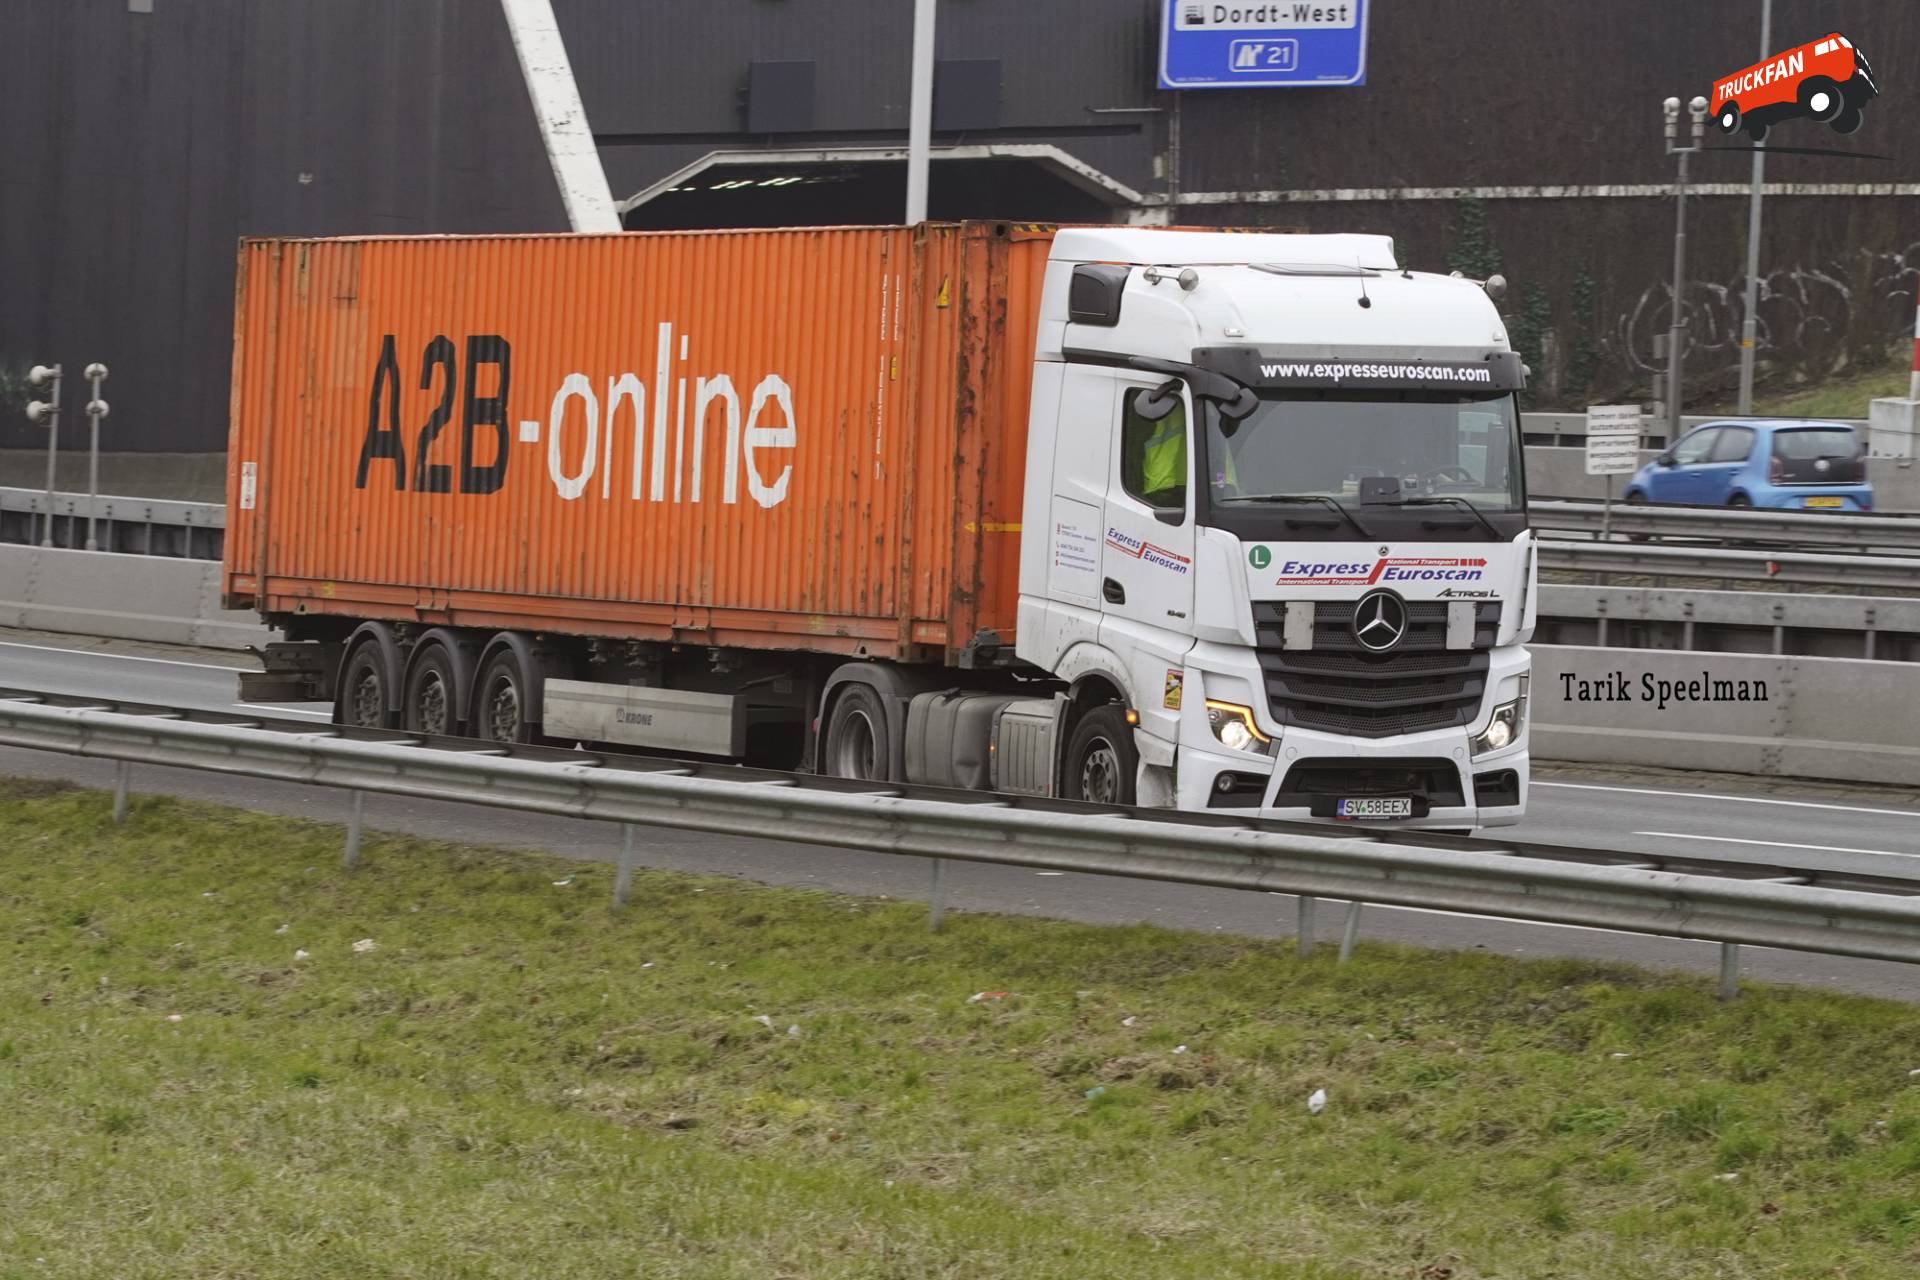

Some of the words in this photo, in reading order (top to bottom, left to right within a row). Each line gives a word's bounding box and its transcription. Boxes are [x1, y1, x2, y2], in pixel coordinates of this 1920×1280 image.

[1213, 4, 1349, 24] Dordt-West
[1266, 46, 1290, 65] 21
[1260, 362, 1491, 382] www.expresseuroscan.com
[355, 321, 797, 508] A2B-online
[1107, 527, 1140, 549] Express
[1143, 550, 1187, 574] Euroscan
[1254, 550, 1264, 565] L
[1280, 561, 1371, 578] Express
[1382, 567, 1483, 582] Euroscan
[1436, 588, 1489, 598] ACTROS
[1490, 589, 1500, 598] L
